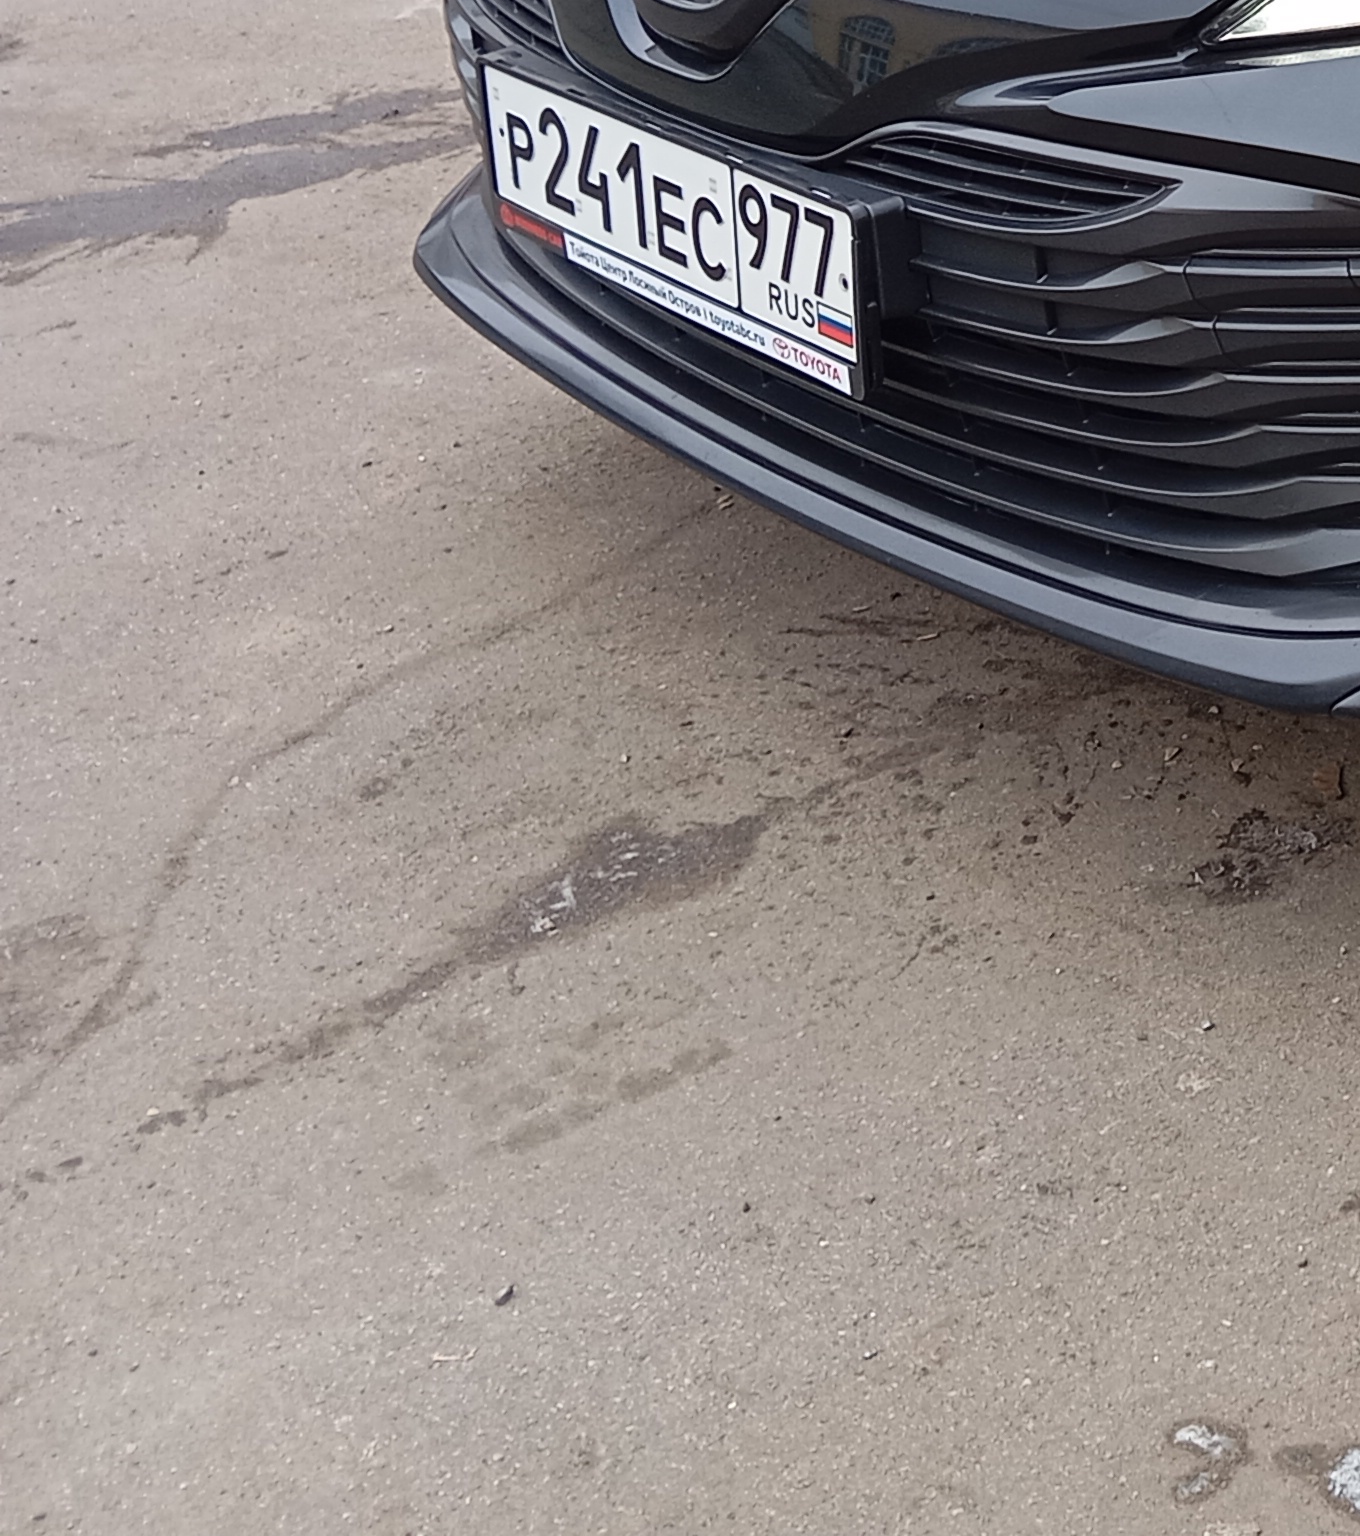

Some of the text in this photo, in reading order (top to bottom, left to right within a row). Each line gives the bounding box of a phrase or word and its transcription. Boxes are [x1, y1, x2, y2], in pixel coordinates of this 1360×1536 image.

[738, 183, 834, 298] 977
[768, 283, 816, 329] RUS
[790, 347, 842, 383] TOYOTA
